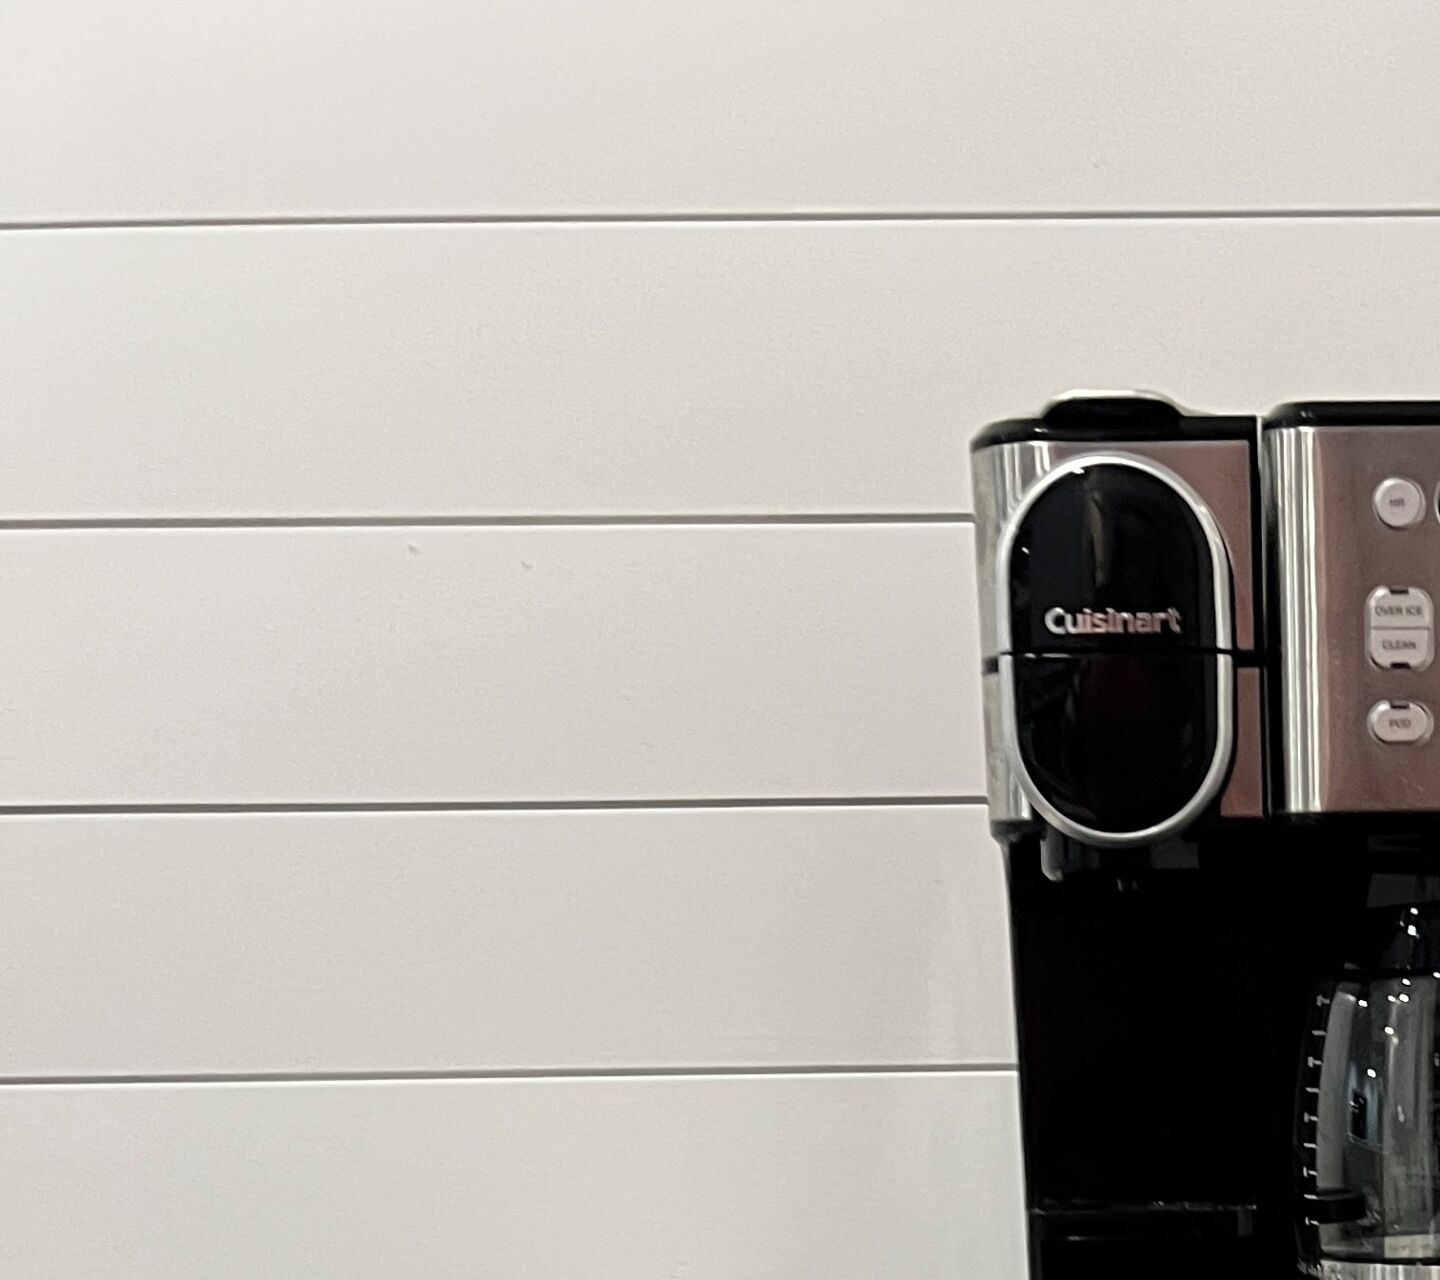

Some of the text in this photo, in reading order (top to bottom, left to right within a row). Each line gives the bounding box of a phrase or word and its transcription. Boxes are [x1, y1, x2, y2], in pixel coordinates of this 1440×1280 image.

[1374, 605, 1422, 616] OVER ICE
[1044, 606, 1182, 635] Cuisinart
[1382, 640, 1417, 650] CLEAN
[1388, 718, 1412, 729] POD
